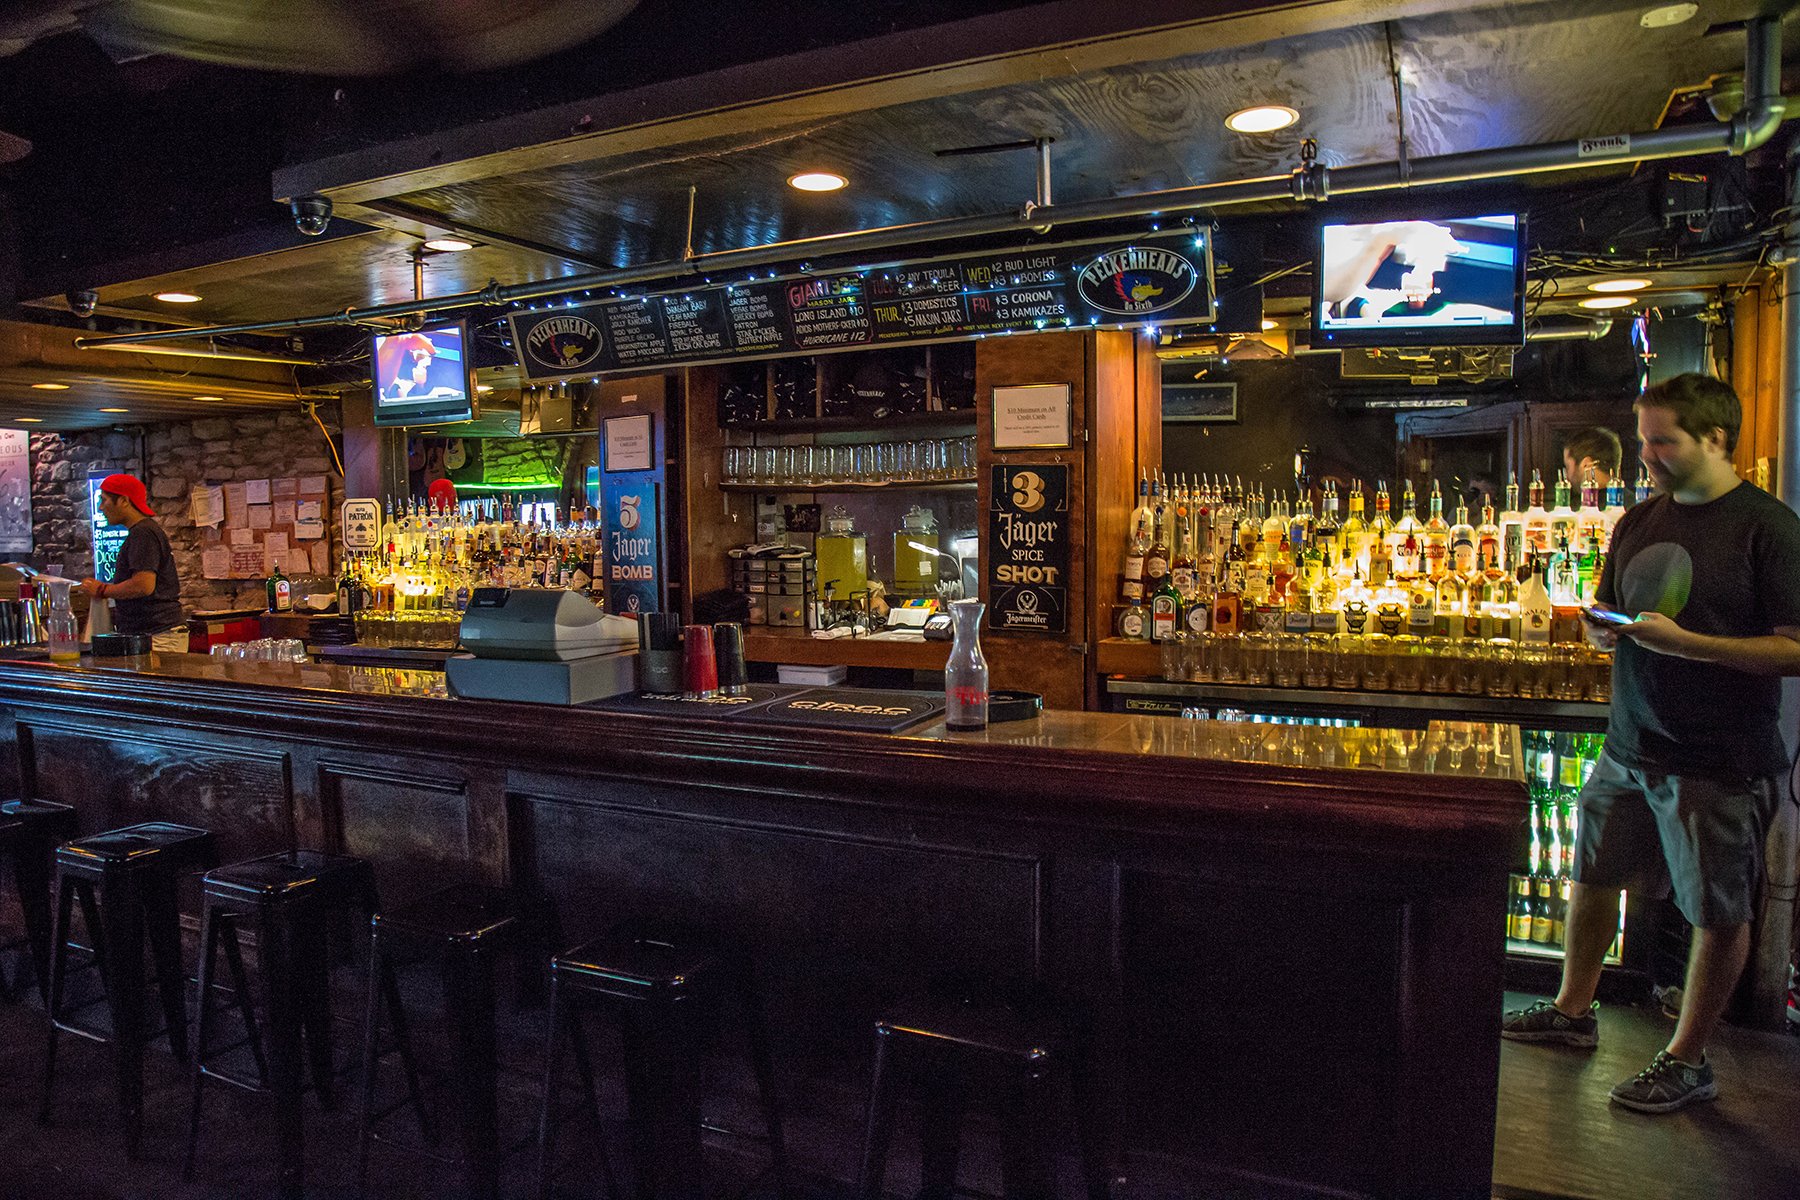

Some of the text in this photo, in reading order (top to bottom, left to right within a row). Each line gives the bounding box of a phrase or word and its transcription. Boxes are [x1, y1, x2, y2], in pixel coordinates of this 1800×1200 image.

[1004, 259, 1025, 272] BUD
[1025, 256, 1057, 270] LIGHT
[1084, 251, 1188, 288] PECKERHEADS
[907, 271, 921, 282] ANY
[922, 267, 956, 280] TEQUILA
[789, 278, 831, 309] GIANT
[936, 279, 960, 293] BEER
[807, 295, 857, 307] MASON JARS
[913, 296, 959, 312] DOMESTICS
[1011, 289, 1055, 304] CORONA
[690, 299, 707, 311] BABY
[1011, 303, 1065, 319] KAMIKAZES
[1134, 300, 1153, 310] Sixth
[793, 310, 815, 322] LONG
[816, 306, 848, 320] ISLAND
[915, 311, 942, 328] MASON
[941, 308, 963, 324] JARS
[528, 318, 596, 348] PECKERHEADS
[668, 320, 699, 330] FIREBALL
[733, 321, 759, 330] PATRON
[649, 338, 666, 348] APPLE
[802, 332, 849, 346] HURRICANE
[1012, 470, 1046, 513] 3
[620, 494, 641, 530] 5
[997, 512, 1059, 550] Jäger
[1011, 549, 1045, 562] SPICE
[611, 564, 654, 581] BOMB
[996, 563, 1060, 586] SHOT
[1006, 612, 1048, 625] Jägermeister
